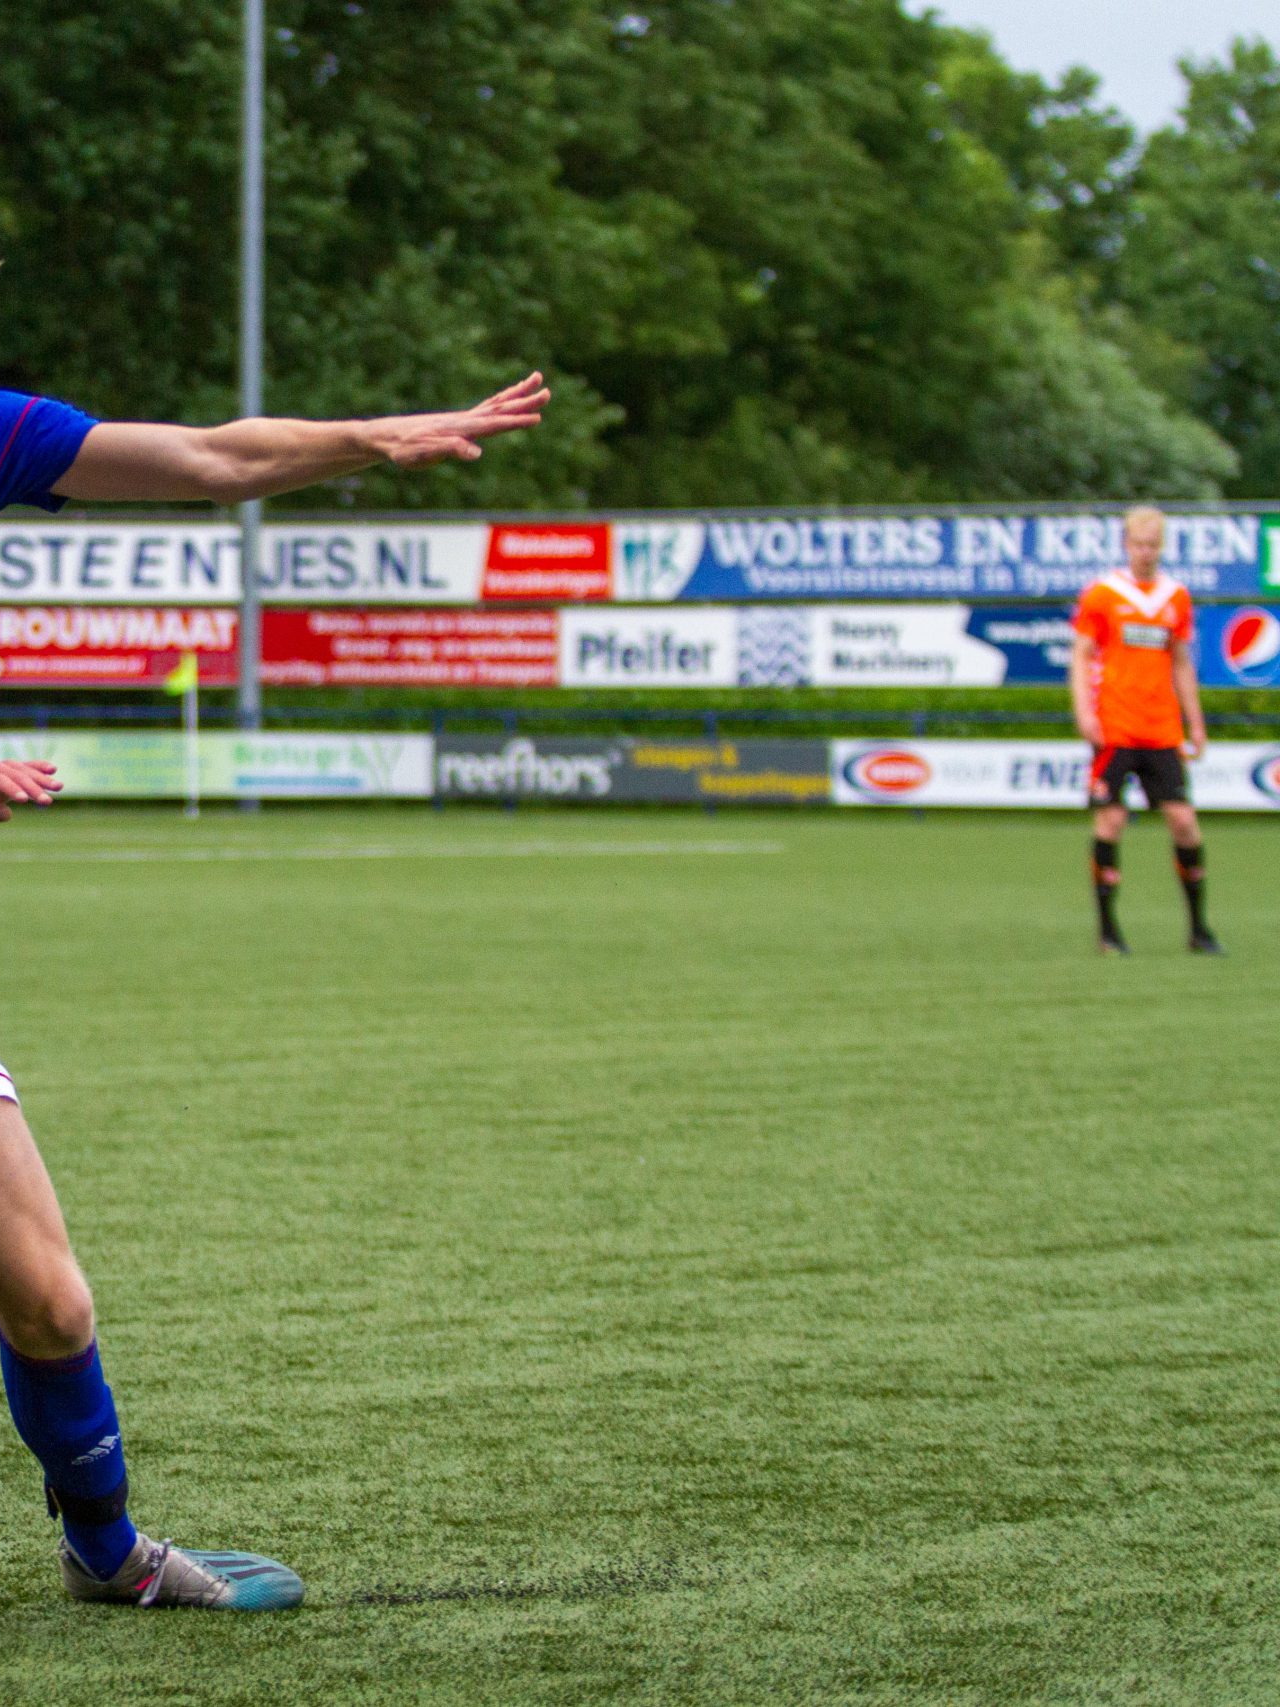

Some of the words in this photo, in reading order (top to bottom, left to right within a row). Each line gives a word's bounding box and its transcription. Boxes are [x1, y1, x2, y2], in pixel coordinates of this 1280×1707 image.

[708, 517, 944, 568] WOLTERS
[955, 516, 1026, 567] EN
[1036, 514, 1261, 566] KRITEN
[577, 630, 716, 673] Pfeifer
